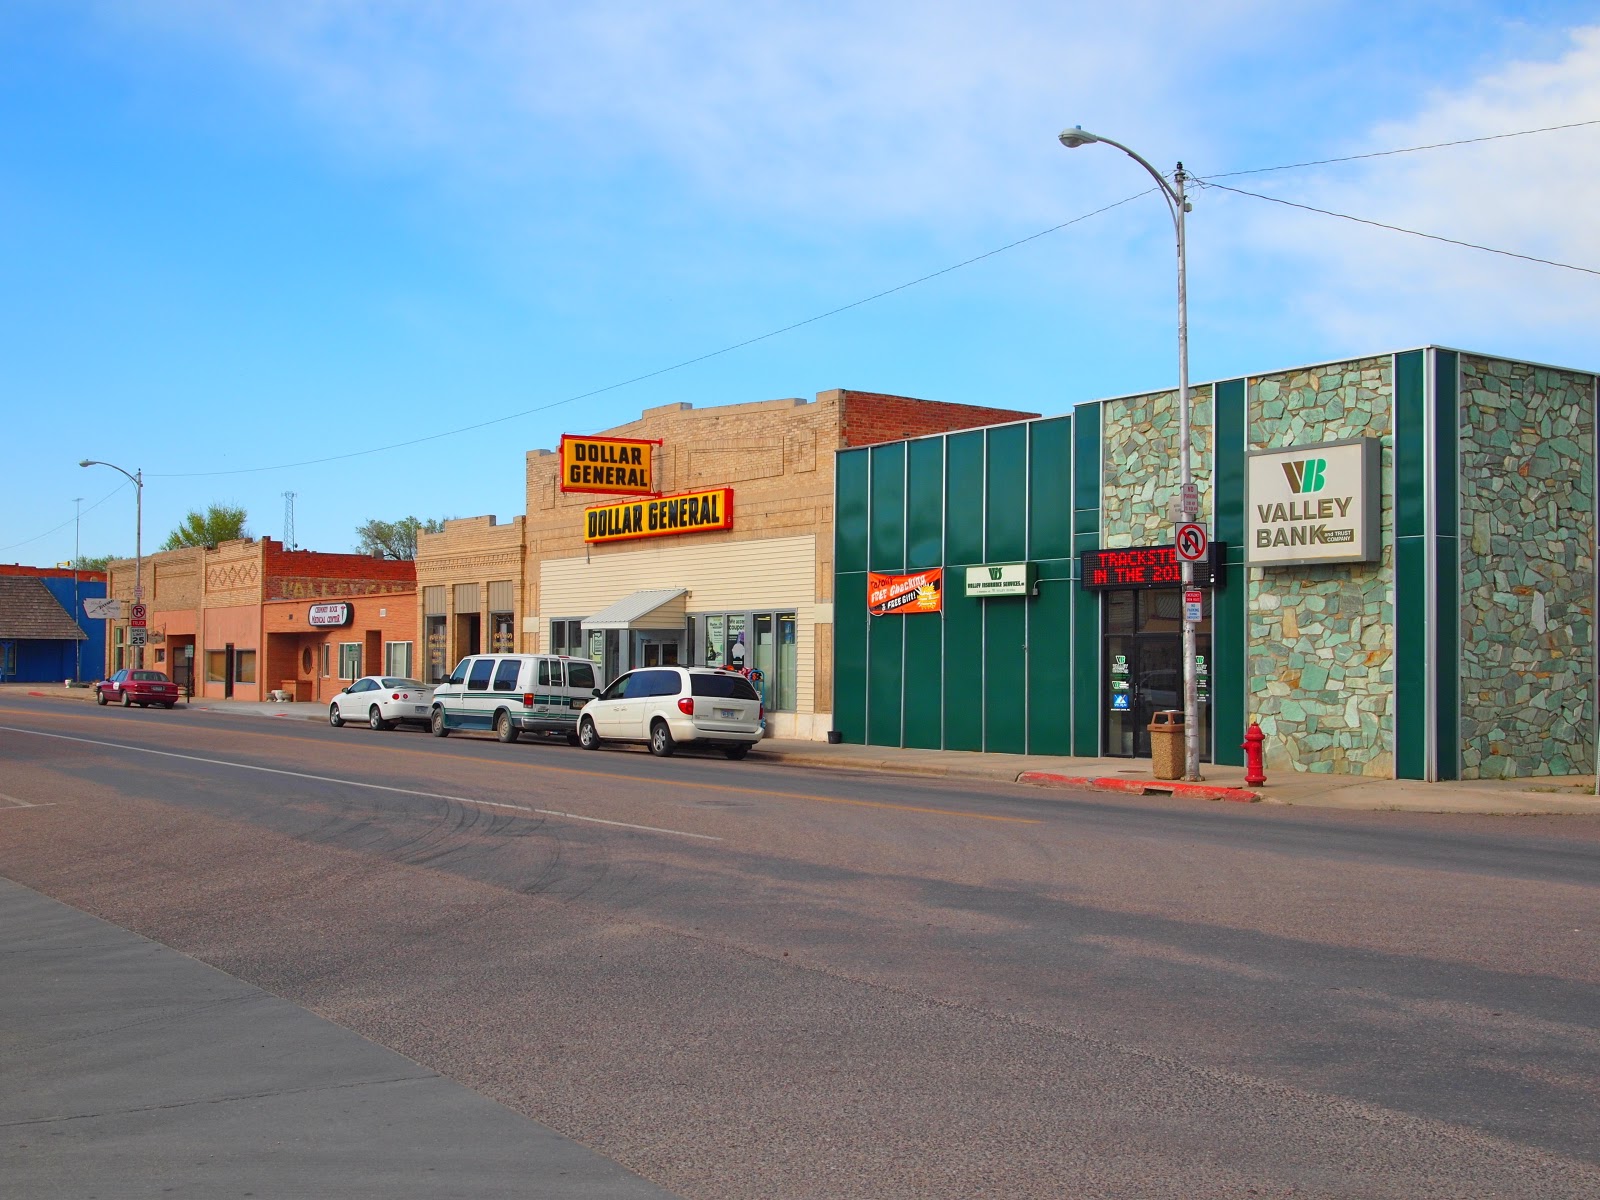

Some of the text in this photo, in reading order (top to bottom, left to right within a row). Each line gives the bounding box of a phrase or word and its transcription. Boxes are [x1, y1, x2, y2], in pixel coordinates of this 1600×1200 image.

[574, 443, 642, 465] DOLLAR
[570, 464, 648, 487] GENERAL
[588, 494, 720, 538] DOLLAR GENERAL
[1257, 496, 1353, 523] VALLEY
[1256, 524, 1327, 548] BANK
[1098, 548, 1177, 567] TRACKSTE
[1093, 565, 1181, 585] IN THE 201
[871, 588, 888, 603] FREE
[889, 574, 927, 597] Checking
[887, 597, 902, 609] FREE
[312, 614, 340, 623] MEDICAL CENTER
